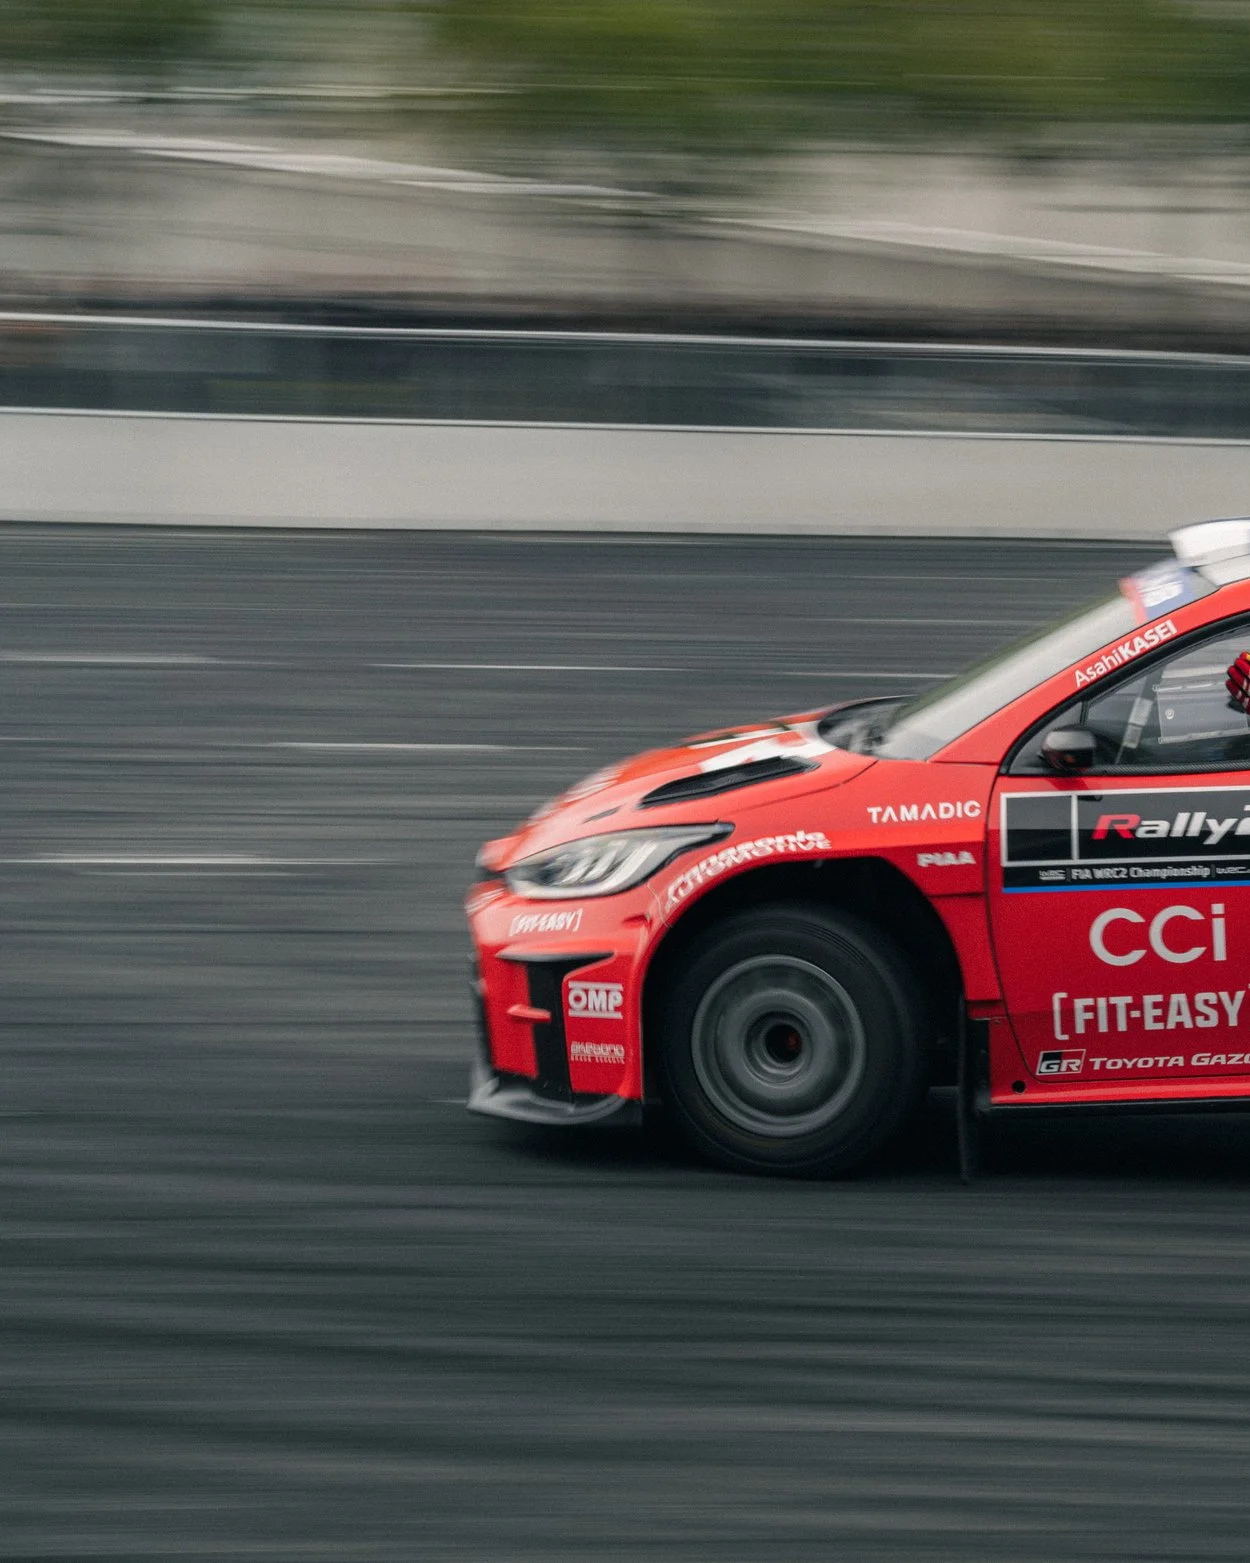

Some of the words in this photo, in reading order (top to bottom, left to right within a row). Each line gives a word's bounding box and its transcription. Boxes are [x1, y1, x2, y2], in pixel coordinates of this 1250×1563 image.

[866, 800, 982, 824] TAMADIC
[1071, 868, 1093, 880] FIA
[1092, 867, 1128, 879] WRC2
[1129, 865, 1211, 879] Championship
[568, 988, 624, 1013] OMP
[1040, 1059, 1082, 1074] GR
[1089, 1056, 1185, 1071] TOYOTA
